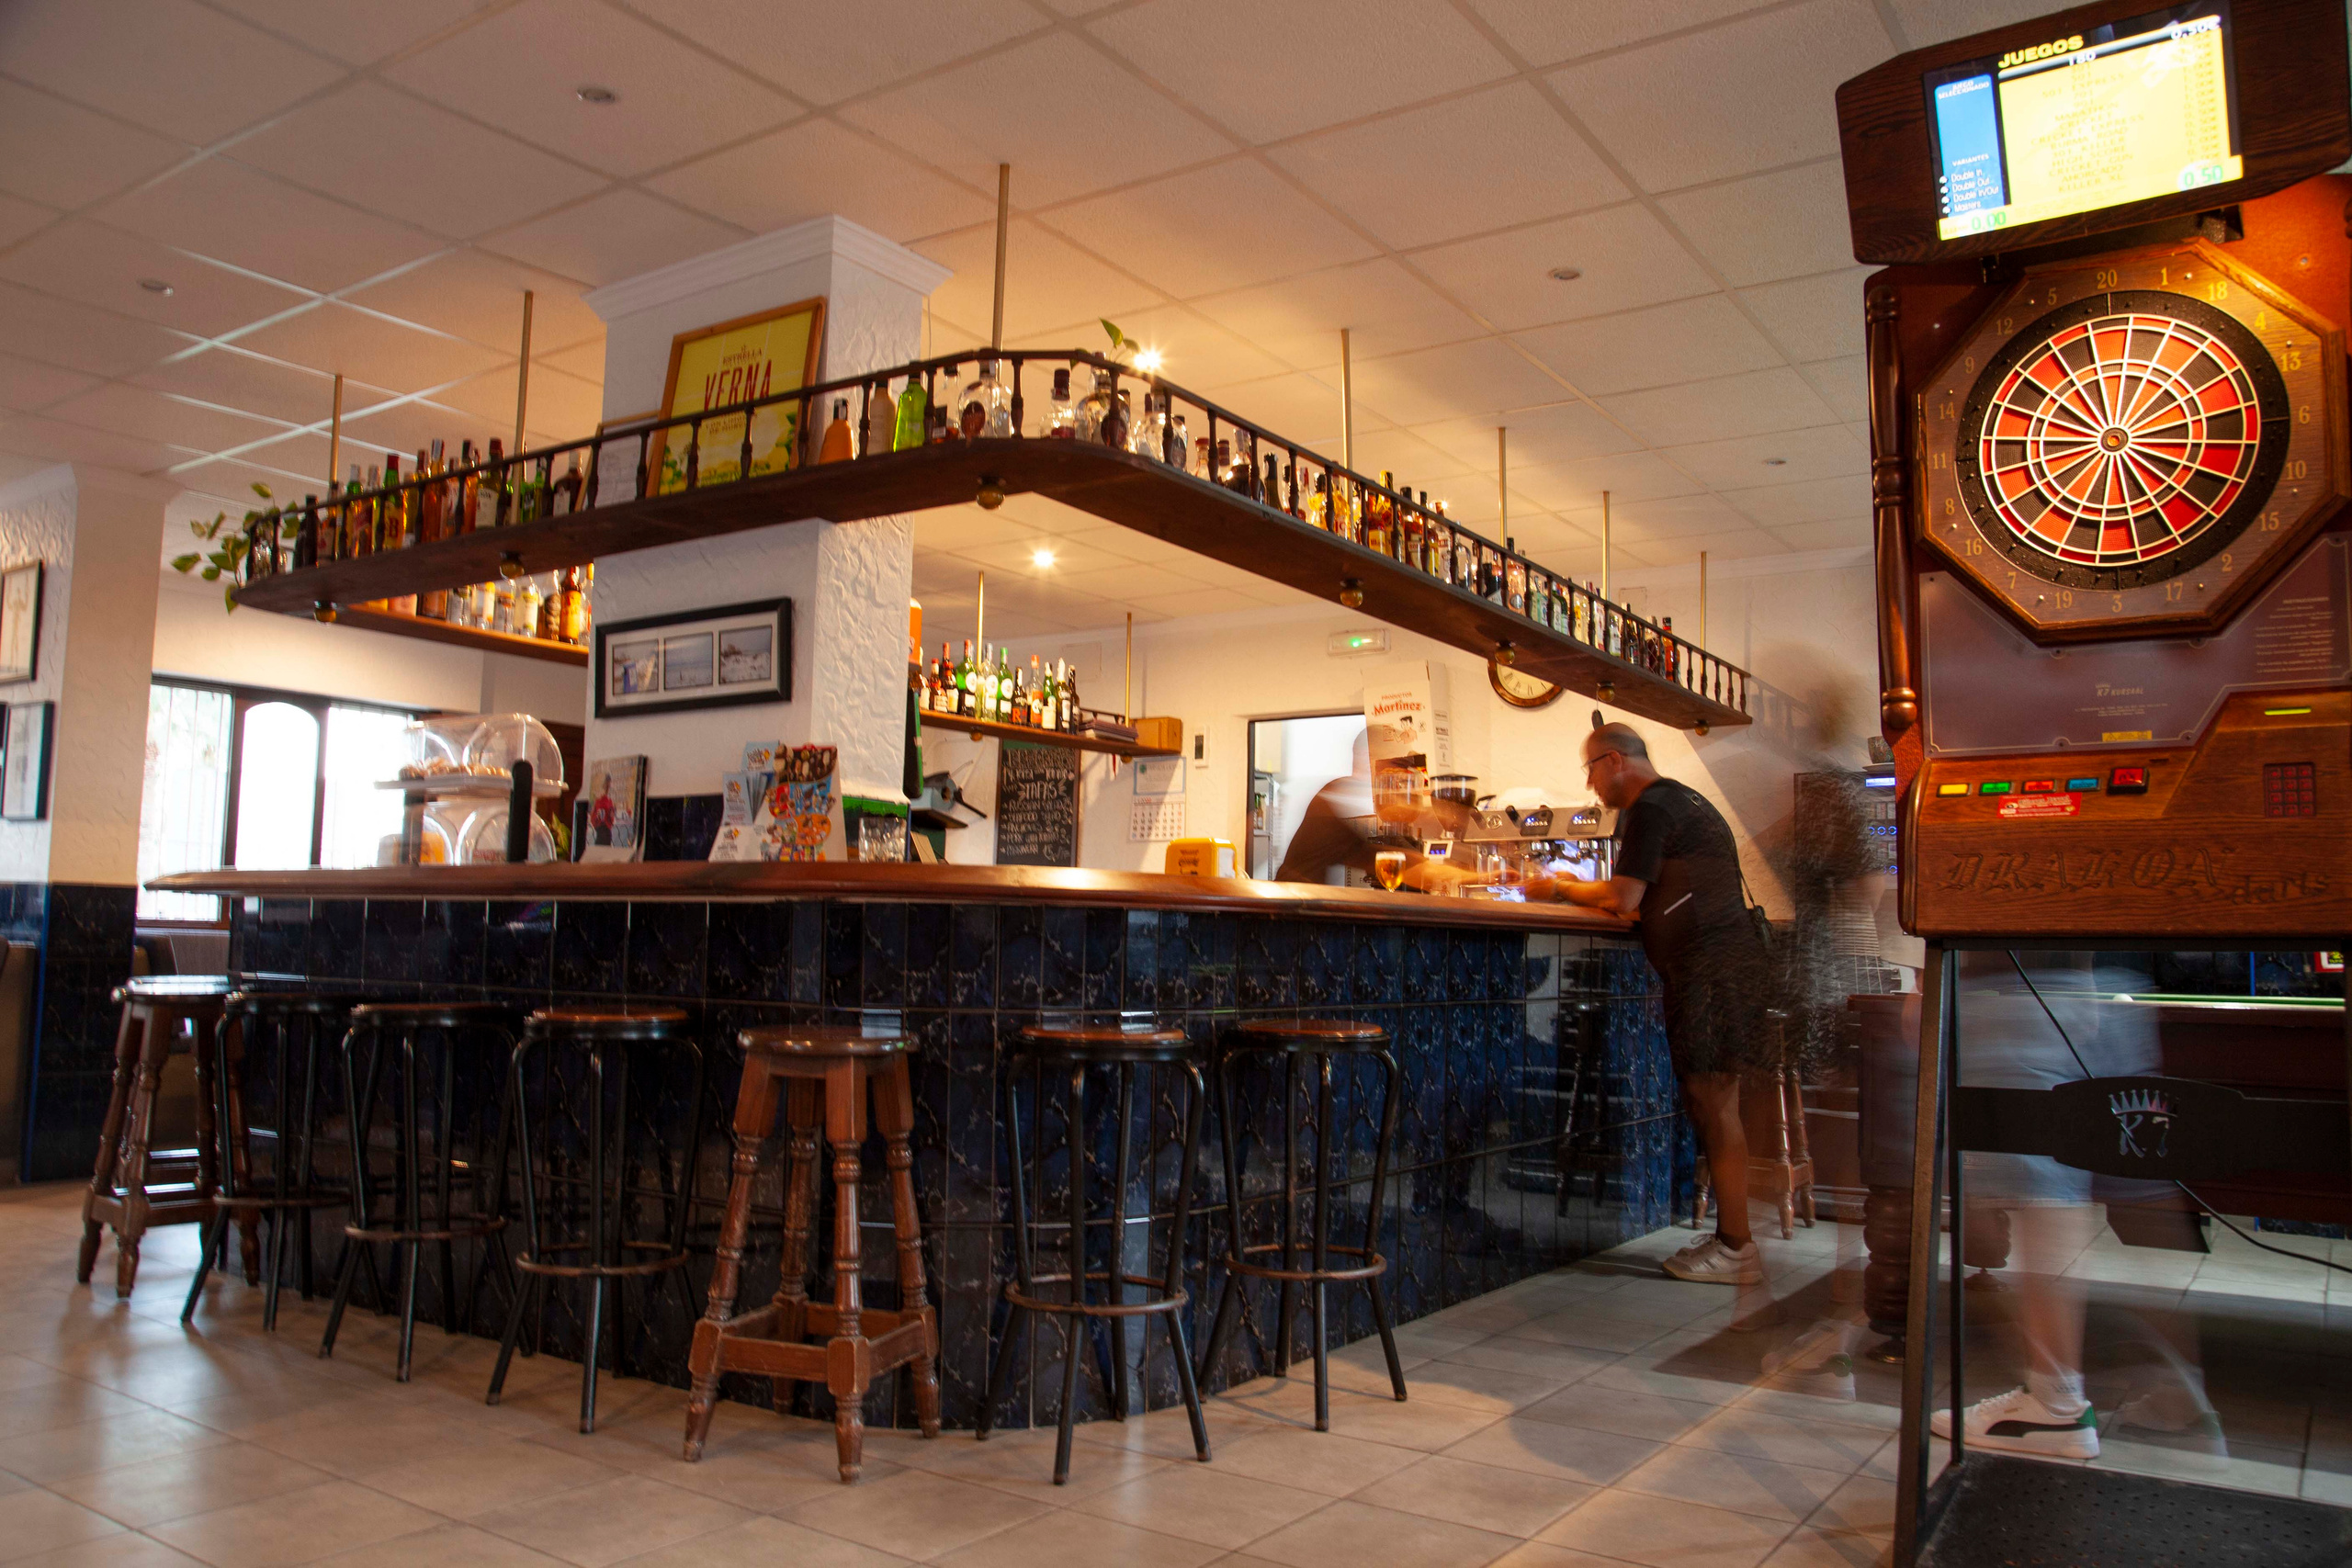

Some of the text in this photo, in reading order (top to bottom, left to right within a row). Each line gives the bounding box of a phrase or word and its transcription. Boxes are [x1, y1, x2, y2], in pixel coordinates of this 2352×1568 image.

[1997, 35, 2084, 69] JUEGOS
[2067, 50, 2096, 66] 180
[1952, 153, 1989, 166] VARIANTES
[1951, 171, 1974, 183] Double
[1952, 177, 1990, 193] Double Out
[2184, 164, 2223, 188] 0.50
[1953, 191, 1976, 203] Double
[1972, 211, 2007, 231] 0.00
[2097, 269, 2118, 288] 20
[2160, 266, 2169, 286] 1
[2046, 288, 2058, 306] 5
[2207, 280, 2228, 300] 18
[1996, 317, 2014, 336] 12
[2254, 311, 2267, 330] 4
[1964, 356, 1975, 374] 9
[2280, 352, 2302, 372] 13
[1939, 402, 1956, 420] 14
[2298, 405, 2311, 424] 6
[1932, 452, 1948, 469] 11
[2286, 461, 2307, 479] 10
[1944, 498, 1956, 515] 8
[2259, 513, 2280, 531] 15
[1964, 538, 1984, 557] 16
[2222, 554, 2233, 571] 2
[2007, 572, 2018, 591] 7
[2054, 591, 2073, 611] 19
[2165, 582, 2184, 602] 17
[2111, 593, 2123, 613] 3
[2231, 871, 2333, 906] darts
